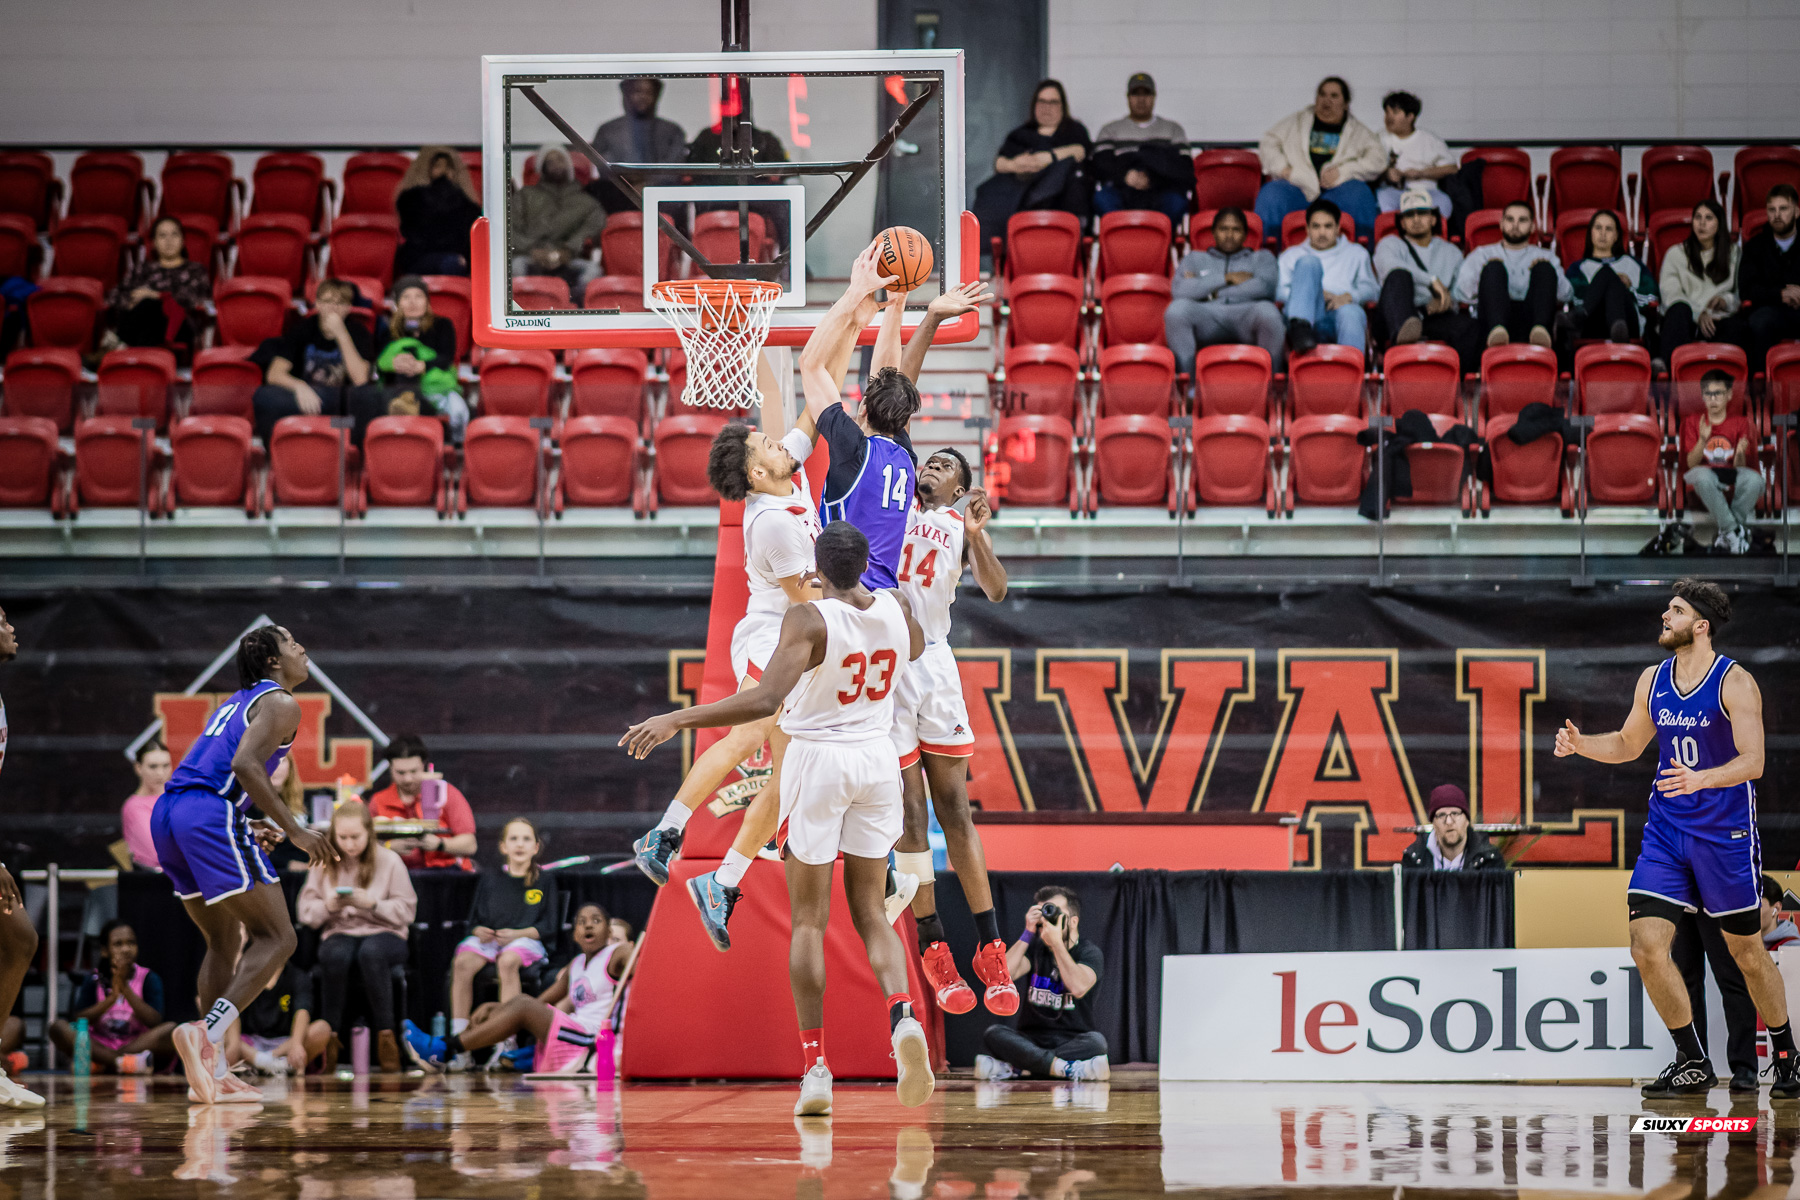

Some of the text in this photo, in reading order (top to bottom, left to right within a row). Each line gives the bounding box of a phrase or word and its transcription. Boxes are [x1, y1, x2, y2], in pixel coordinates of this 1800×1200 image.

[505, 317, 551, 328] SPALDING
[881, 463, 909, 512] 14
[904, 523, 951, 549] AVAL
[898, 542, 939, 588] 14
[836, 648, 899, 706] 33
[1657, 708, 1711, 731] Bishop's
[668, 648, 1627, 868] VAL
[1671, 735, 1699, 768] 10
[1028, 985, 1076, 1009] ASKETBLL
[1671, 1068, 1708, 1087] AIR
